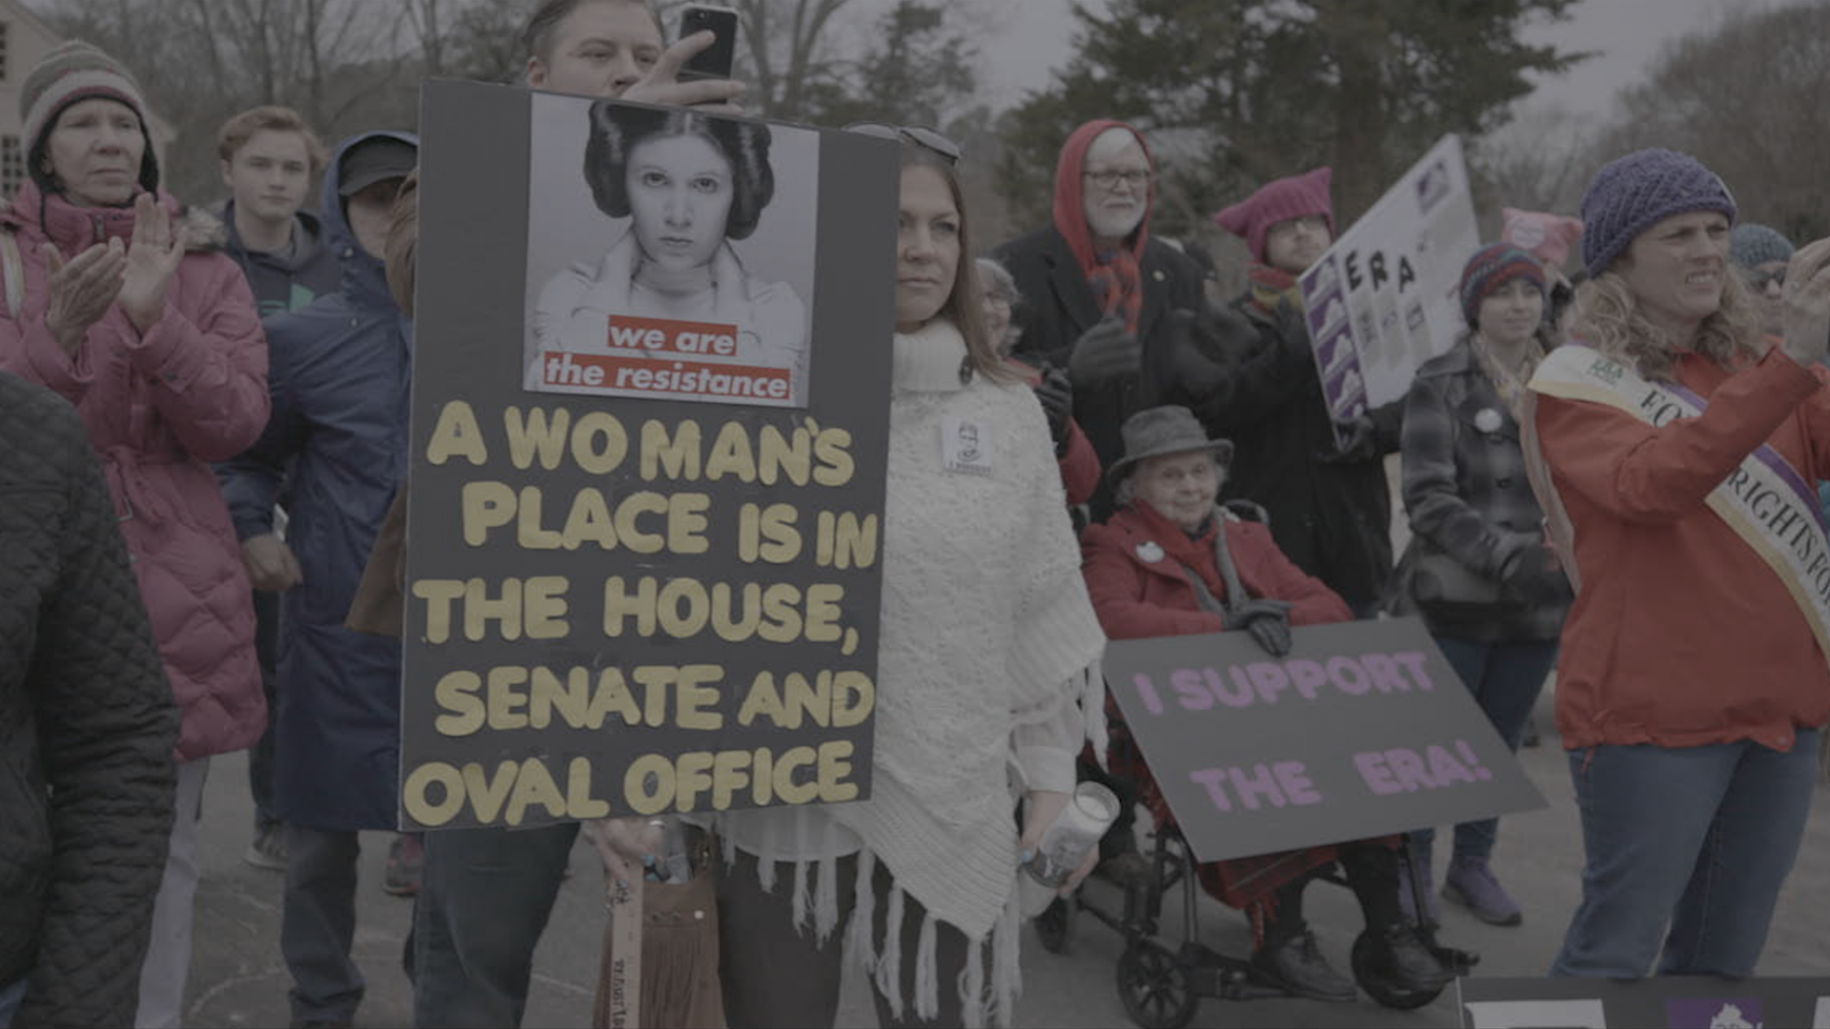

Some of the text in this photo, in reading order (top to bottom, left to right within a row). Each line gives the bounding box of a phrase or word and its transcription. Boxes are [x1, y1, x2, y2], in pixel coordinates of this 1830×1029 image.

[1345, 250, 1416, 294] ERA
[610, 325, 735, 355] we are
[546, 353, 790, 399] the resistance
[1641, 389, 1692, 428] FO
[426, 400, 488, 466] A
[462, 481, 879, 570] PLACE IS IN
[1727, 466, 1819, 562] RIGHTS
[412, 575, 859, 656] THE HOUSE,
[435, 664, 875, 737] SENATE AND
[1132, 651, 1436, 716] I SUPPORT
[403, 739, 859, 827] OVAL OFFICE
[1189, 738, 1494, 813] THE ERA!
